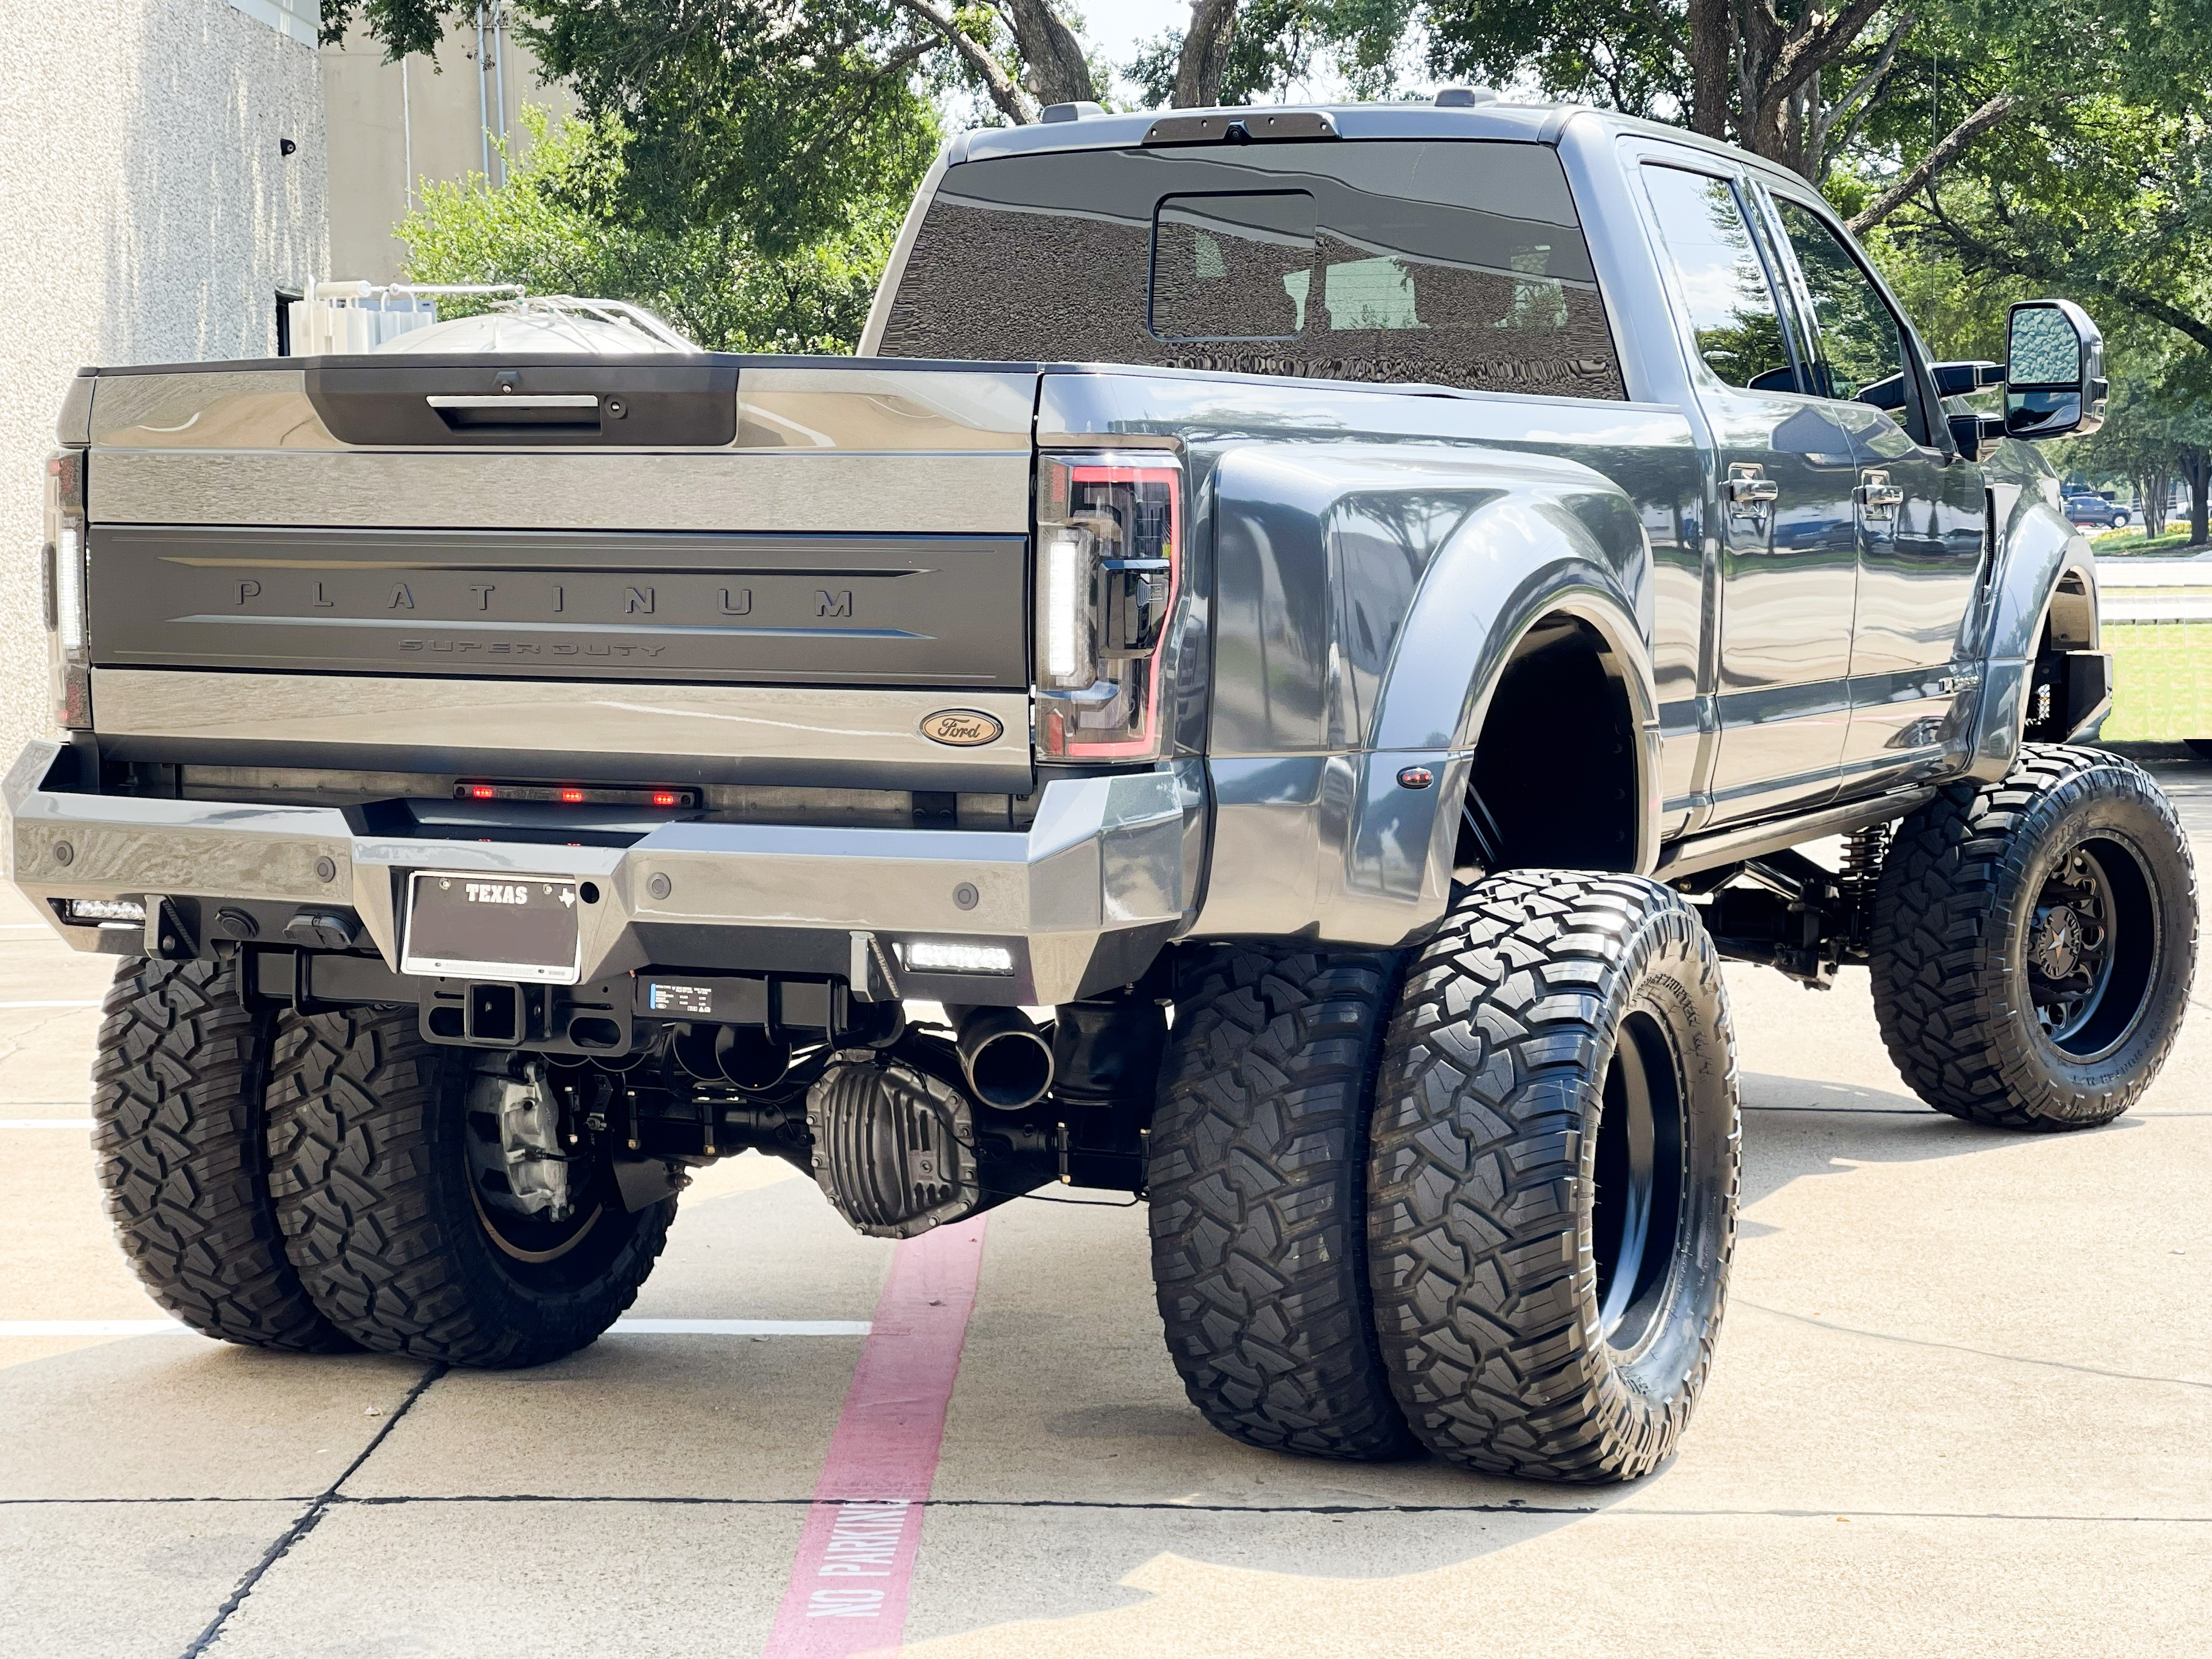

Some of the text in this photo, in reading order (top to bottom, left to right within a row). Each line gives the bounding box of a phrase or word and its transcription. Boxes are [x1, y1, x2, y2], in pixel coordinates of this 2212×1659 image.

[234, 580, 853, 617] PLATINUM
[398, 639, 666, 657] SUPER DUTY
[938, 718, 981, 738] Ford
[465, 883, 528, 905] TEXAS
[805, 1588, 885, 1617] NO
